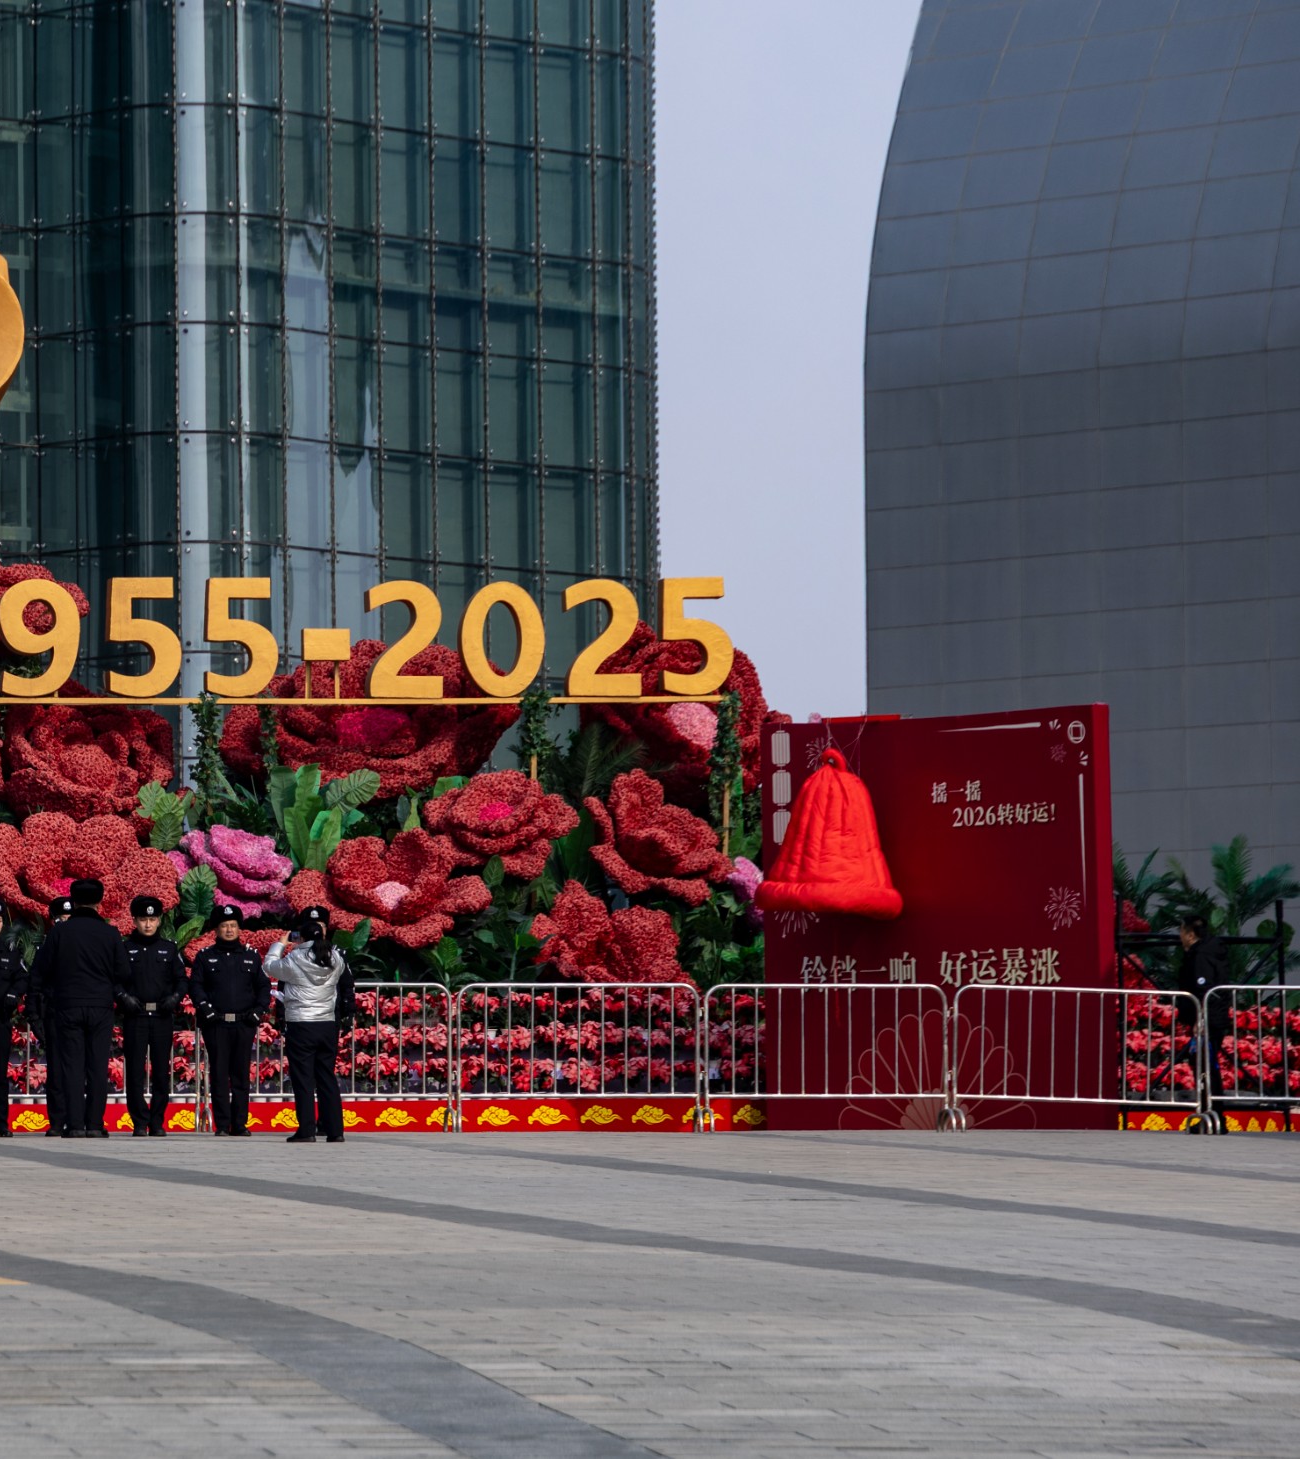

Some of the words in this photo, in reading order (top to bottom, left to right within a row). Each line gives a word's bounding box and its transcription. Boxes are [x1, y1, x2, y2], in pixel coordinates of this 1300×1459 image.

[931, 780, 981, 804] 摇一摇
[952, 802, 1056, 828] 2026转好运!
[800, 952, 917, 992] 铃铛一响
[938, 947, 1061, 987] 好运暴涨
